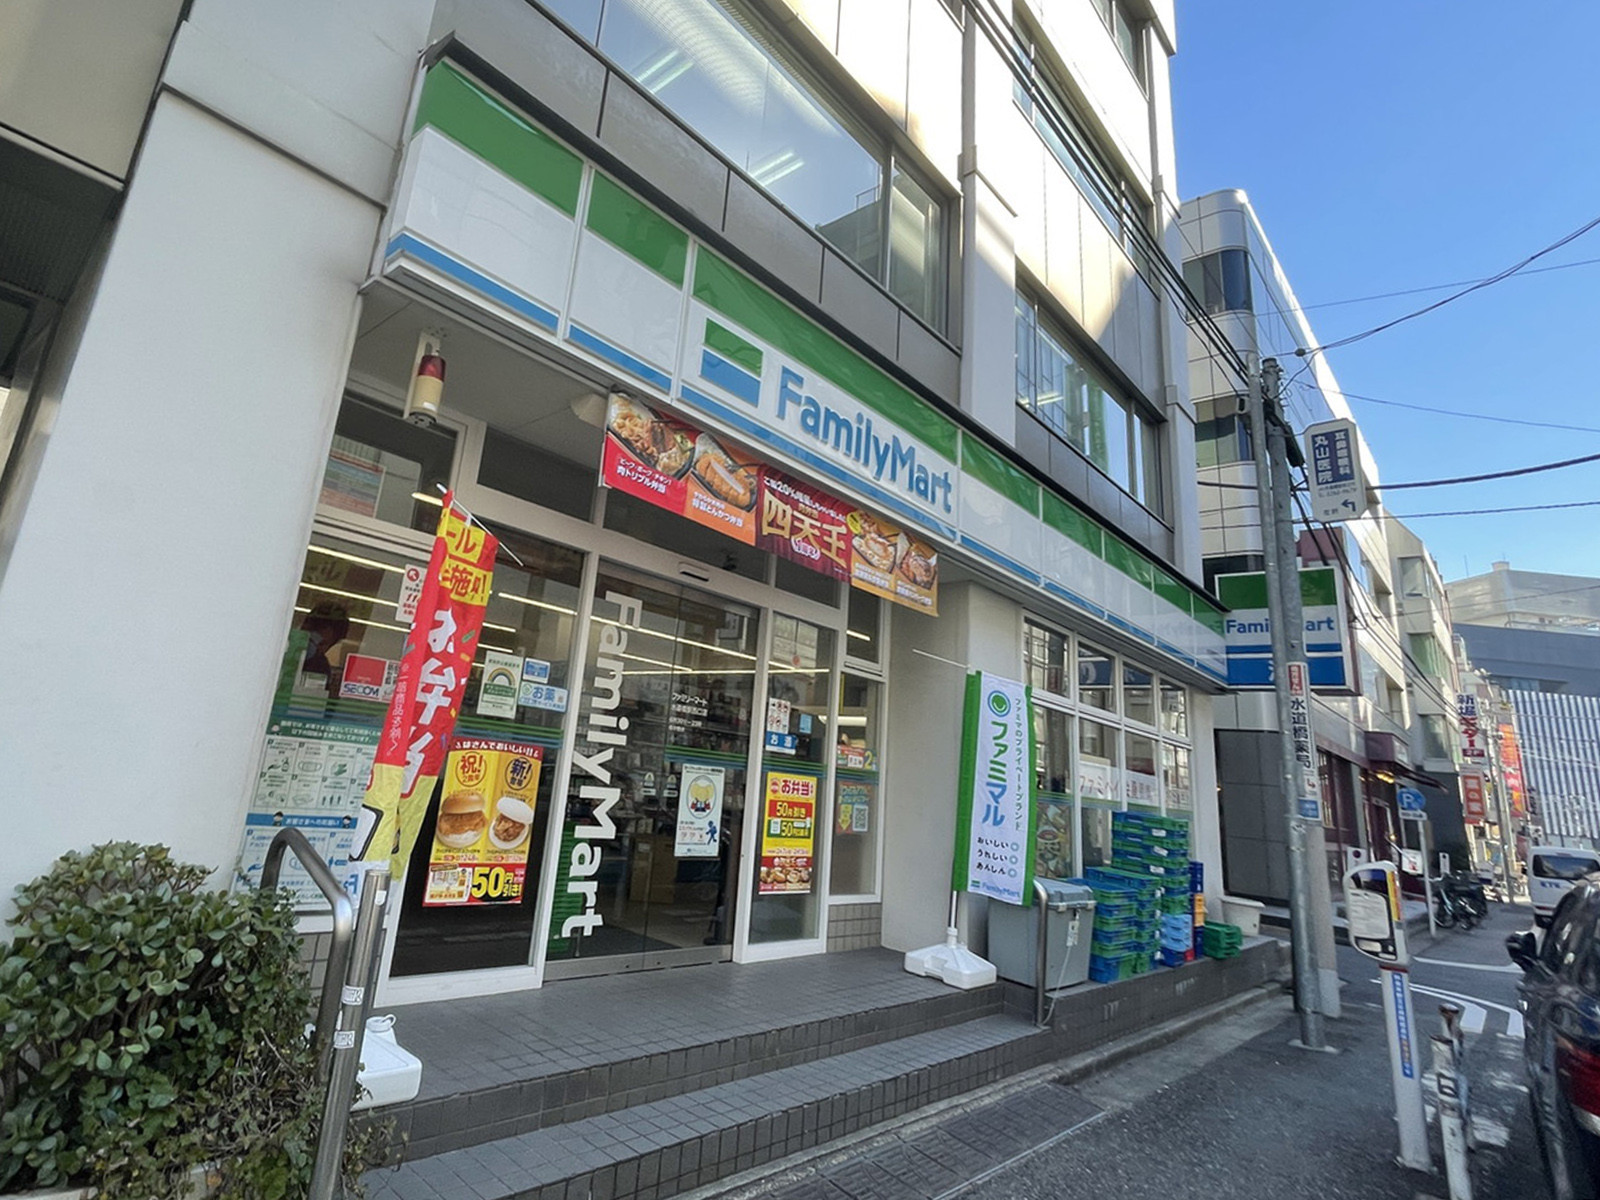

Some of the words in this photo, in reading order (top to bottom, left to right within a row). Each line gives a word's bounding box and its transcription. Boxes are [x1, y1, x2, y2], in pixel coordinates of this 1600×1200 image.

[776, 365, 952, 514] FamilyMart
[1313, 435, 1334, 483] 丸山医院
[763, 488, 850, 568] 四天王
[1226, 616, 1336, 634] Famiart
[343, 684, 380, 697] SECOM
[461, 755, 484, 775] 祝!
[511, 759, 532, 780] 新!
[561, 590, 643, 939] FamilyMart
[983, 720, 1009, 828] ファミマル
[781, 777, 811, 797] お弁当
[471, 866, 522, 898] 50円引き
